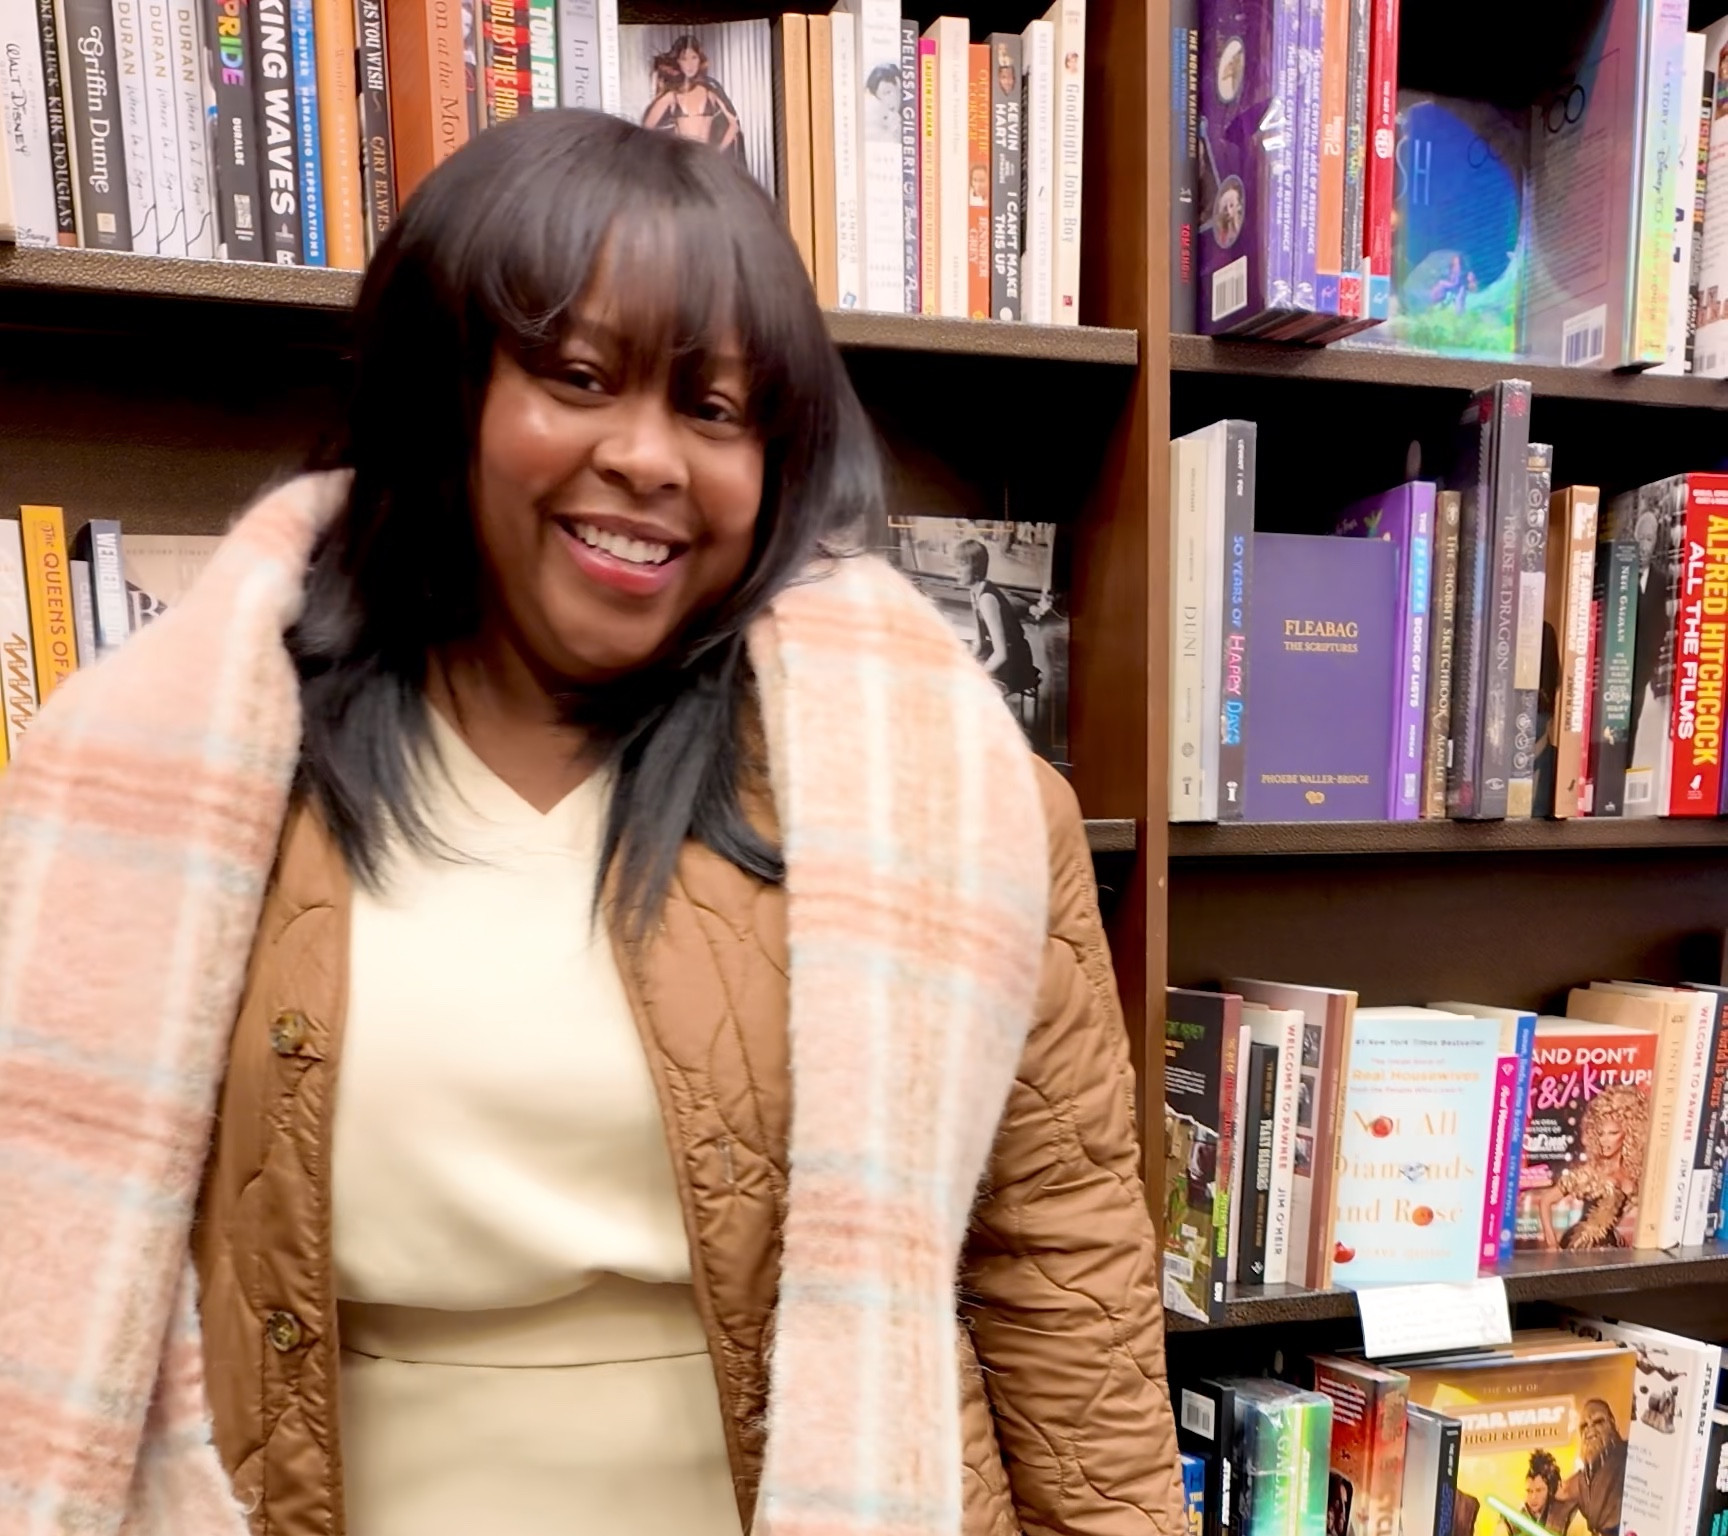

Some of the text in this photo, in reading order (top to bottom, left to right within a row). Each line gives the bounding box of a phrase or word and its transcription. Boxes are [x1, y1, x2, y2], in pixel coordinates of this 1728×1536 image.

[118, 2, 136, 75] DURAN
[149, 4, 167, 79] DURAN
[177, 8, 196, 83] DURAN
[364, 21, 384, 91] YOU WISH
[530, 6, 554, 58] TOM
[78, 25, 110, 194] Griffin Dunne
[902, 29, 916, 179] MELISSA GILBERT
[996, 103, 1008, 147] HART
[1007, 101, 1020, 151] KEVIN
[49, 96, 73, 227] KIRK DOUGLAS
[264, 89, 297, 216] WAVES
[369, 136, 385, 173] CARY
[1061, 83, 1080, 244] Goodnight John Boy
[304, 162, 320, 258] EXPECTATIONS
[1281, 189, 1293, 253] RESISTANCE
[1306, 192, 1318, 256] RESISTANCE
[967, 227, 977, 264] GREY
[978, 215, 989, 279] JENNIFER
[994, 213, 1006, 275] THIS UP
[1006, 201, 1019, 299] CAN'T MAKE
[1447, 535, 1458, 560] THE
[1501, 515, 1516, 572] HOUSE
[43, 552, 69, 669] QUEENS OF
[1284, 619, 1359, 638] FLEABAG
[1409, 512, 1427, 708] THE BOOK OF LISTS
[1496, 591, 1513, 671] DRAGON
[1677, 541, 1705, 740] ALL THE FILMS
[1692, 514, 1728, 765] ALFRED HITCHCOCK
[1227, 636, 1245, 695] HAPPY
[1284, 641, 1359, 653] THE SCRIPTURES
[1437, 627, 1453, 718] SKETCHBOOK
[1226, 700, 1244, 746] DAYS
[1261, 774, 1369, 784] PHOEBE WALLER-BRIDGE
[1352, 1070, 1479, 1081] Real Housewives
[1531, 1048, 1638, 1064] AND DON'T
[1600, 1069, 1653, 1085] IT UP!
[1683, 1006, 1708, 1141] WELCOME TO PAWNEE
[1278, 1025, 1296, 1170] WELCOME TO PAWNEE
[1276, 1187, 1286, 1208] JIM
[1507, 1407, 1566, 1427] WARS
[1526, 1384, 1539, 1392] OF
[1697, 1362, 1712, 1437] STAR WARS
[1464, 1427, 1560, 1446] HIGH REPUBLIC
